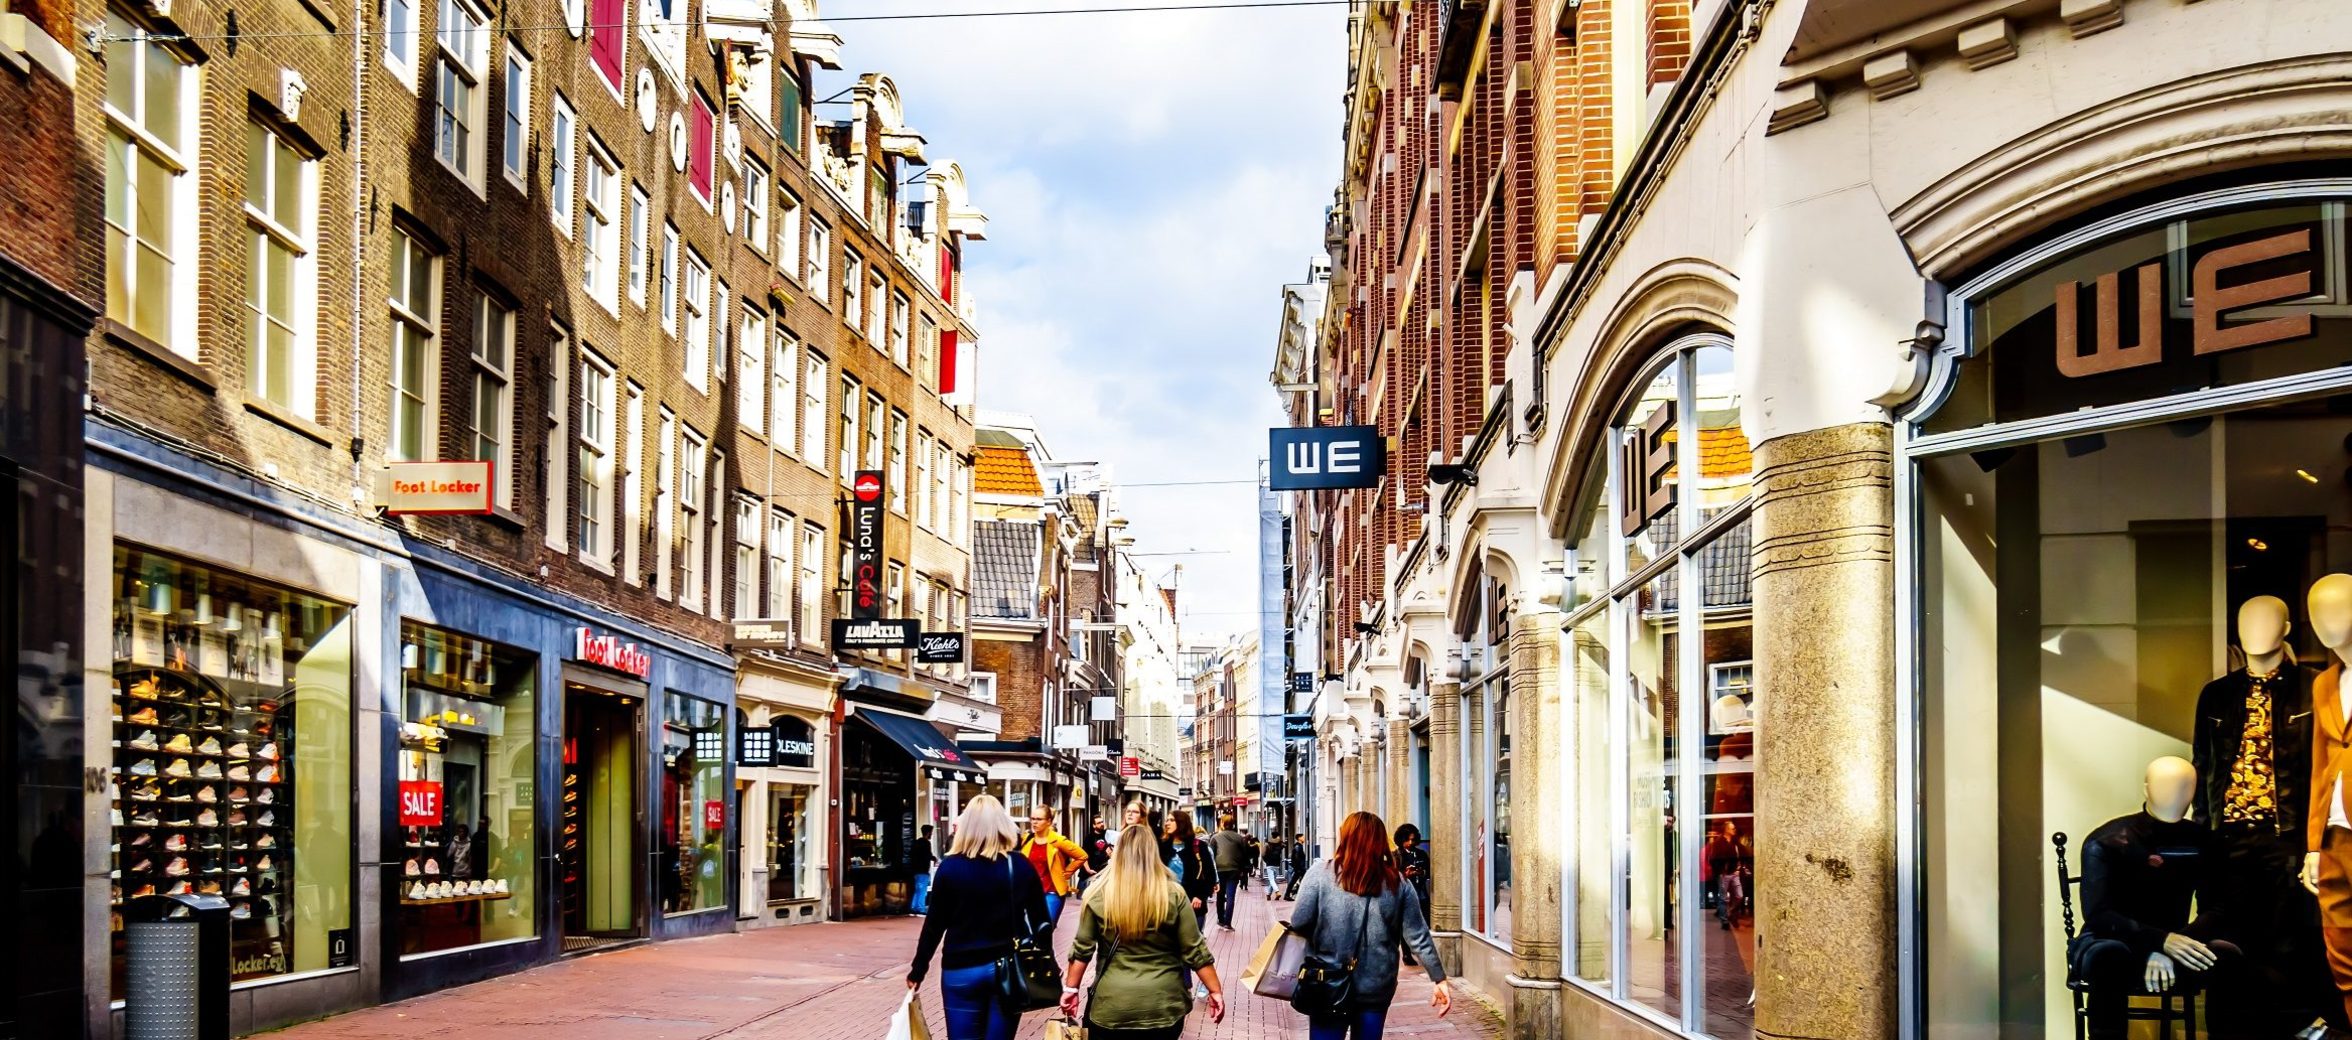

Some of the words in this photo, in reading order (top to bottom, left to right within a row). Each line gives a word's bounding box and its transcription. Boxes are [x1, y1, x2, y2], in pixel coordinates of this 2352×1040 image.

[2056, 229, 2311, 378] WE
[1287, 440, 1361, 474] WE
[1621, 399, 1678, 538] WE
[394, 480, 426, 493] Foot
[431, 480, 481, 493] Locker
[859, 506, 876, 561] Luna's
[845, 621, 905, 638] LAVAZZA
[920, 636, 960, 651] Kiehl's
[579, 627, 609, 666] Foot
[608, 638, 651, 676] Locker
[403, 791, 436, 816] SALE
[708, 806, 721, 823] SALE
